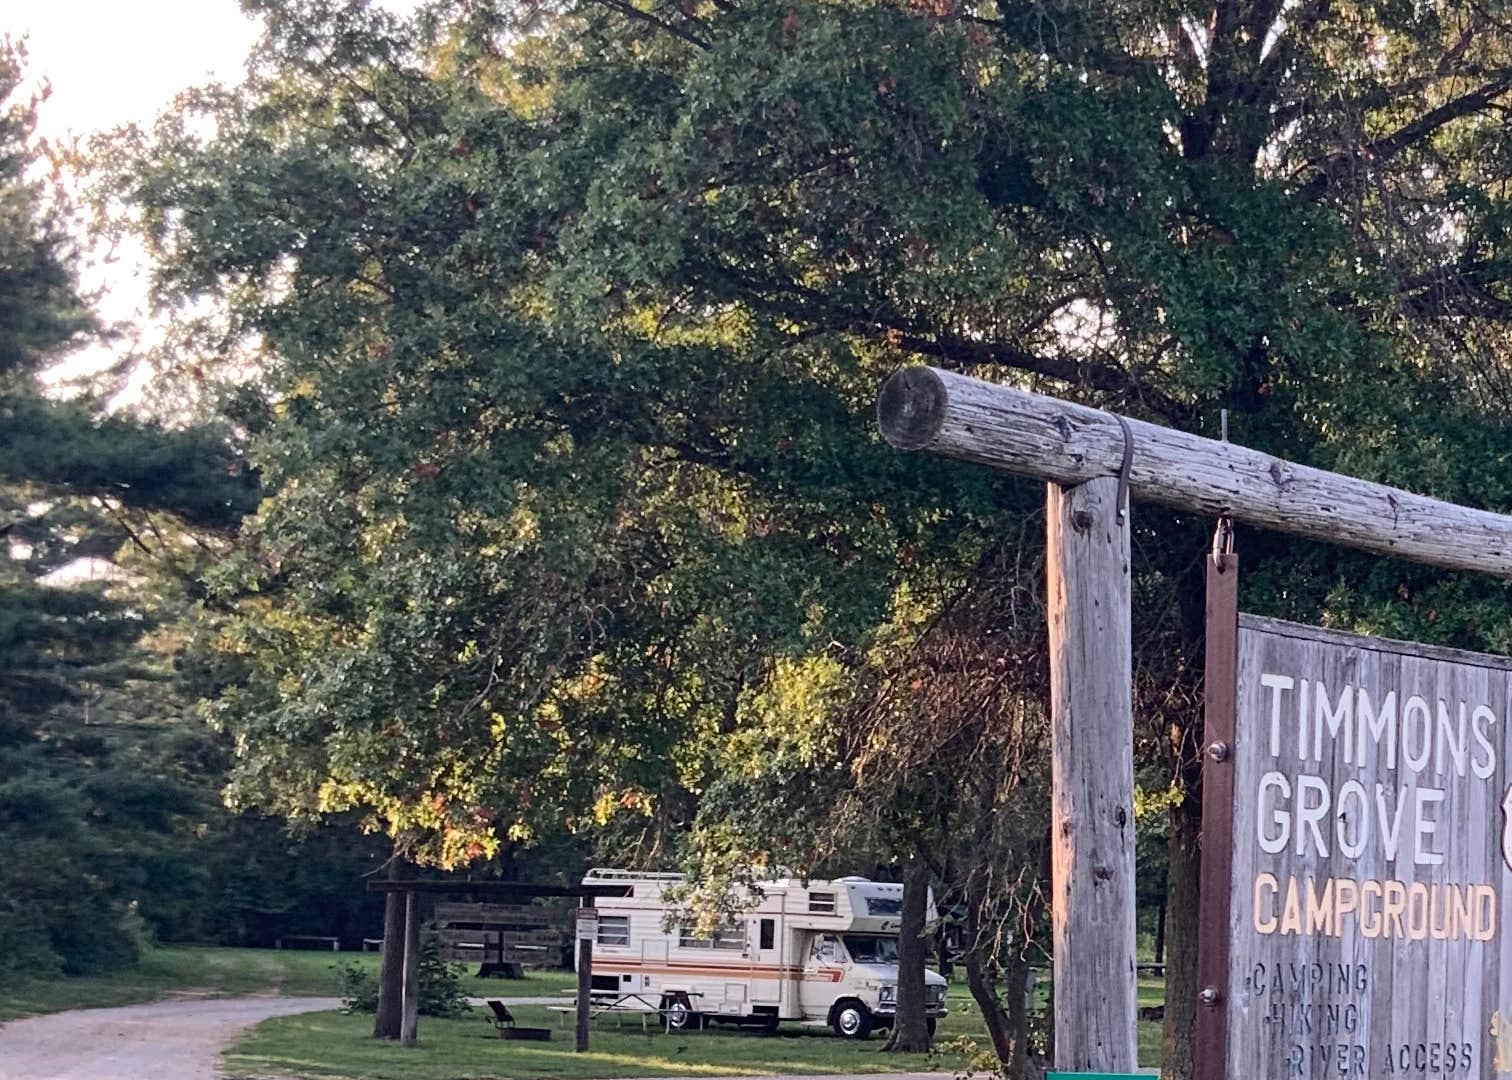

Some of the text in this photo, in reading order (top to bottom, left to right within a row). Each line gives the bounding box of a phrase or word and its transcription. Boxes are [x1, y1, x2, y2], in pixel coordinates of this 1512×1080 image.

[1260, 673, 1497, 779] TIMMONS
[1256, 771, 1444, 865] GROVE
[1253, 872, 1497, 942] CAMPGROUND
[1253, 962, 1367, 996] CAMPING
[1272, 1002, 1357, 1040] HIKING
[1290, 1042, 1473, 1076] RIVER ACCESS
